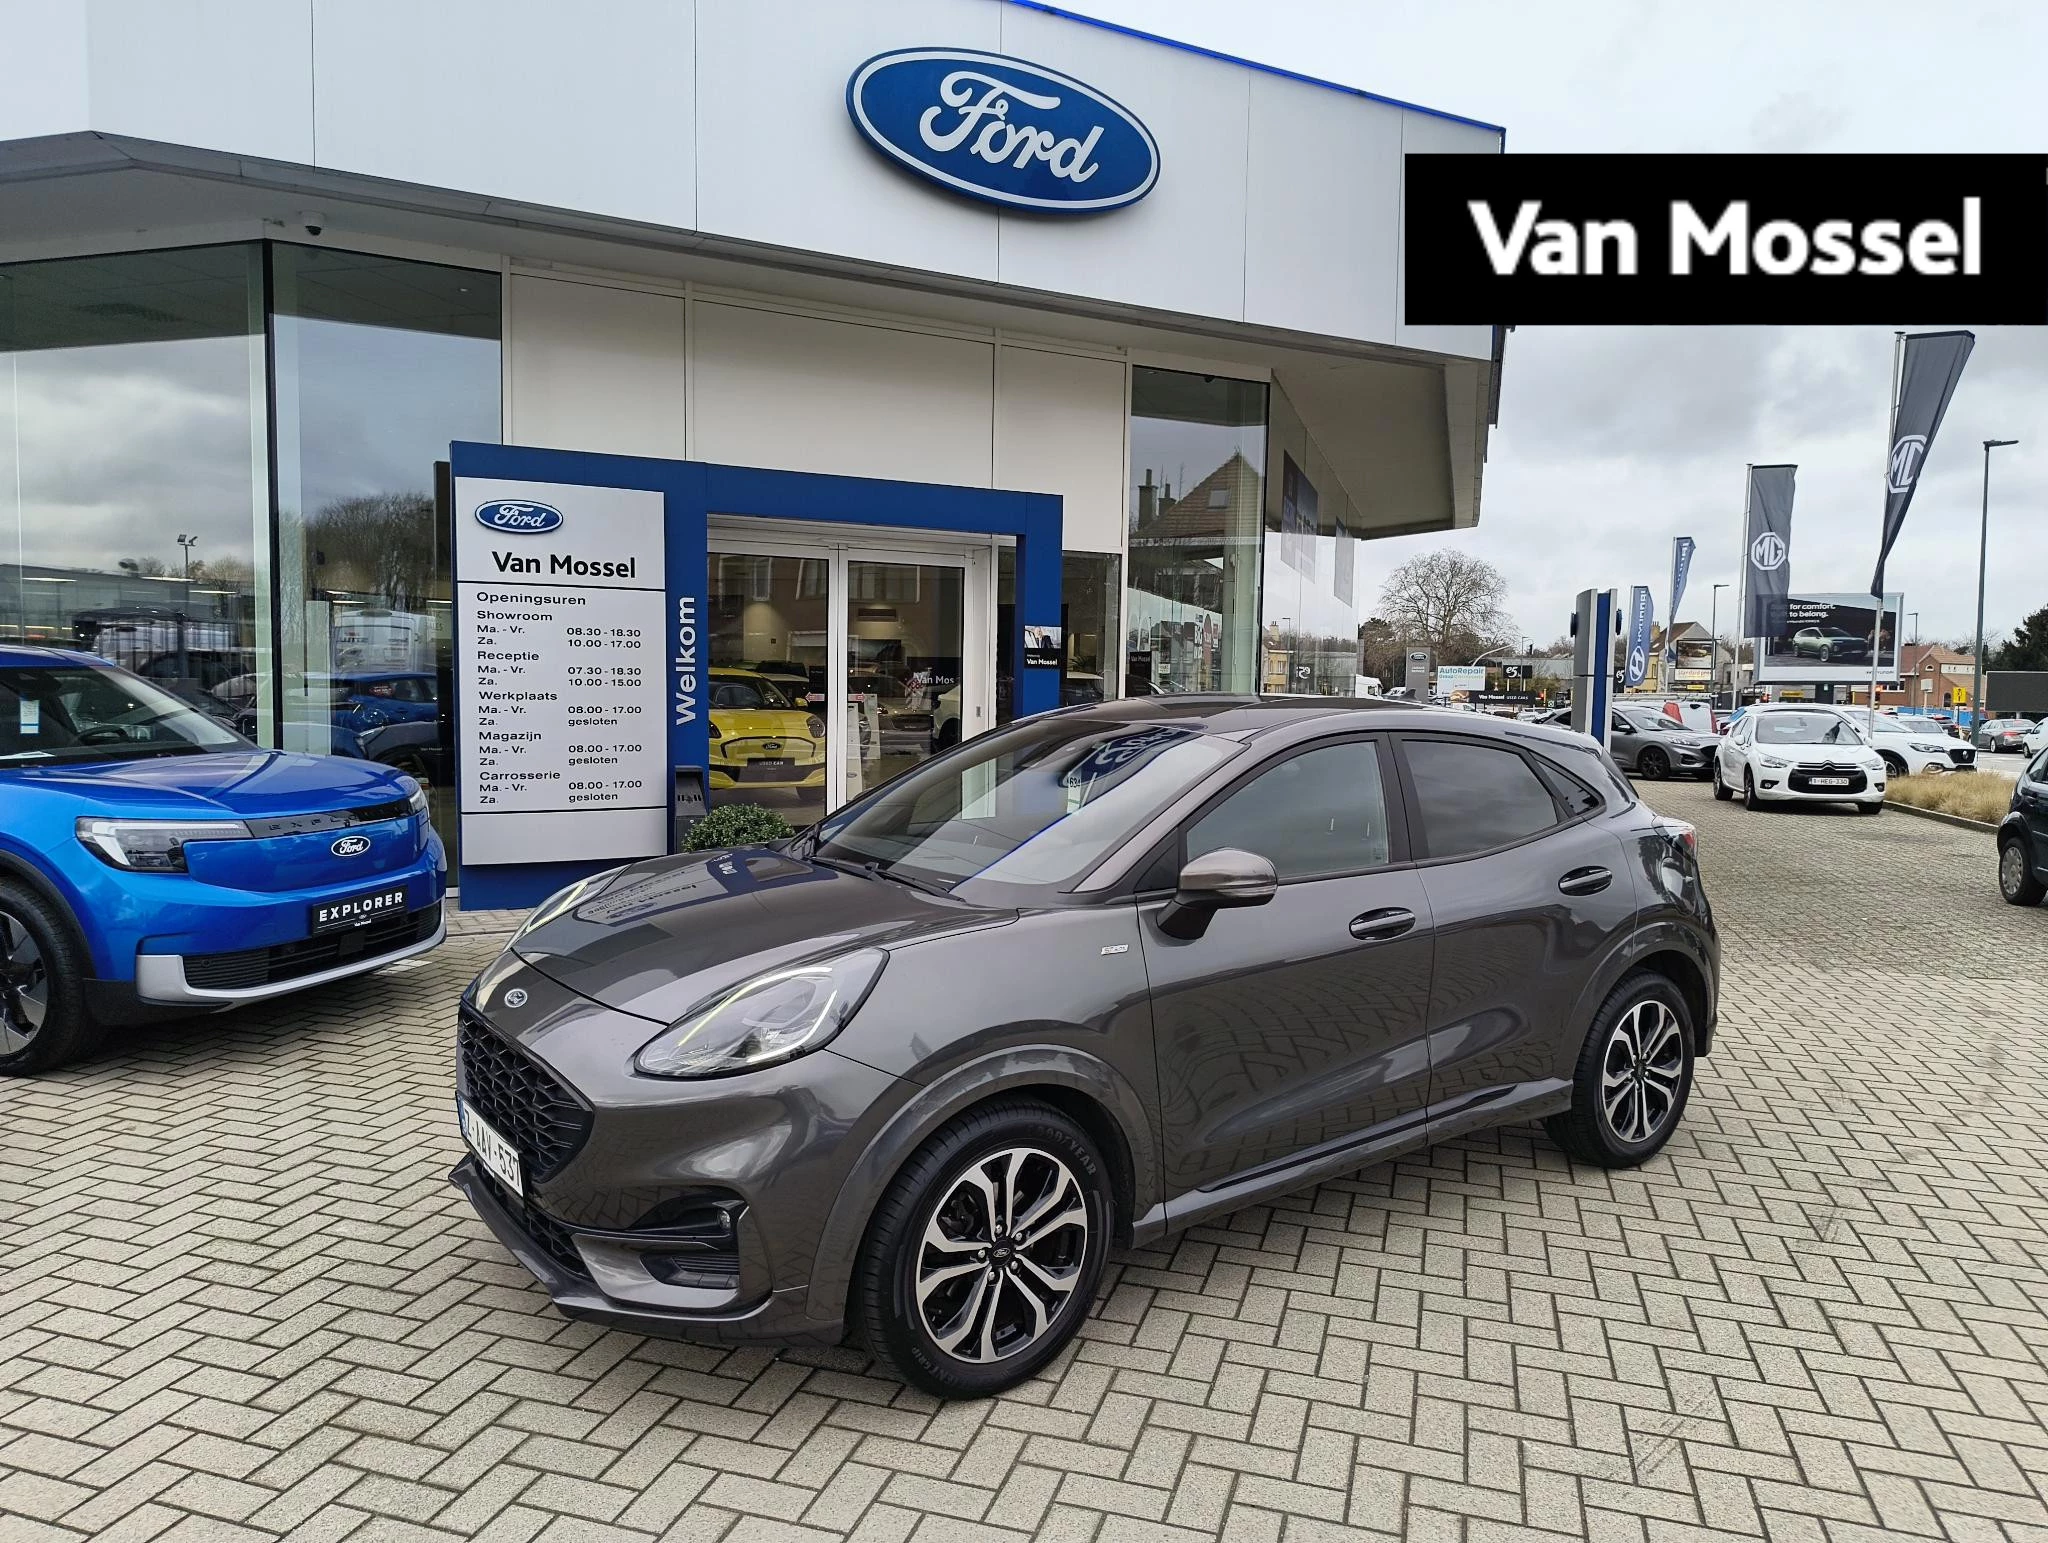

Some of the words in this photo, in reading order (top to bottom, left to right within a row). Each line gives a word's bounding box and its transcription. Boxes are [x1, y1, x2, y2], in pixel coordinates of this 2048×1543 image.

[919, 71, 1104, 183] Ford
[494, 504, 547, 527] Ford
[1754, 538, 1783, 565] MG
[491, 550, 541, 574] Van
[549, 553, 636, 579] Mossel
[476, 591, 586, 606] Openingsuren
[476, 610, 553, 621] Showroom
[476, 624, 500, 633] Ma.
[509, 625, 525, 634] Vr.
[566, 627, 602, 637] 08.30
[609, 628, 641, 638] 18.30
[477, 636, 497, 645] Za.
[567, 638, 602, 648] 10.00
[610, 640, 642, 649] 17.00
[477, 650, 540, 663] Receptie
[675, 596, 697, 726] Welkom
[1038, 658, 1058, 666] Mossel
[477, 665, 501, 674] Ma.
[509, 665, 526, 674] Vr.
[567, 666, 602, 675] 07.30
[610, 667, 642, 676] 18.30
[1439, 667, 1484, 676] AutoRepair
[478, 676, 498, 686] Za.
[568, 678, 603, 687] 10.00
[610, 678, 642, 687] 15.00
[478, 691, 558, 703] Werkplaats
[478, 705, 502, 714] Ma.
[510, 705, 527, 714] Vr.
[567, 705, 603, 714] 08.00
[612, 705, 642, 714] 17.00
[478, 717, 498, 726] Za.
[567, 717, 618, 727] gesloten
[478, 731, 542, 743] Magazijn
[479, 745, 502, 754] Ma.
[511, 745, 527, 754] Vr.
[568, 744, 603, 753] 08.00
[612, 744, 642, 753] 17.00
[479, 757, 499, 766] Za.
[568, 756, 618, 767] gesloten
[479, 770, 561, 781] Carrosserie
[479, 783, 502, 792] Ma.
[511, 783, 528, 792] Vr.
[568, 781, 603, 791] 08.00
[612, 780, 643, 789] 17.00
[479, 795, 499, 804] Za.
[568, 792, 618, 804] gesloten
[339, 839, 364, 854] Ford
[319, 892, 403, 922] EXPLORER
